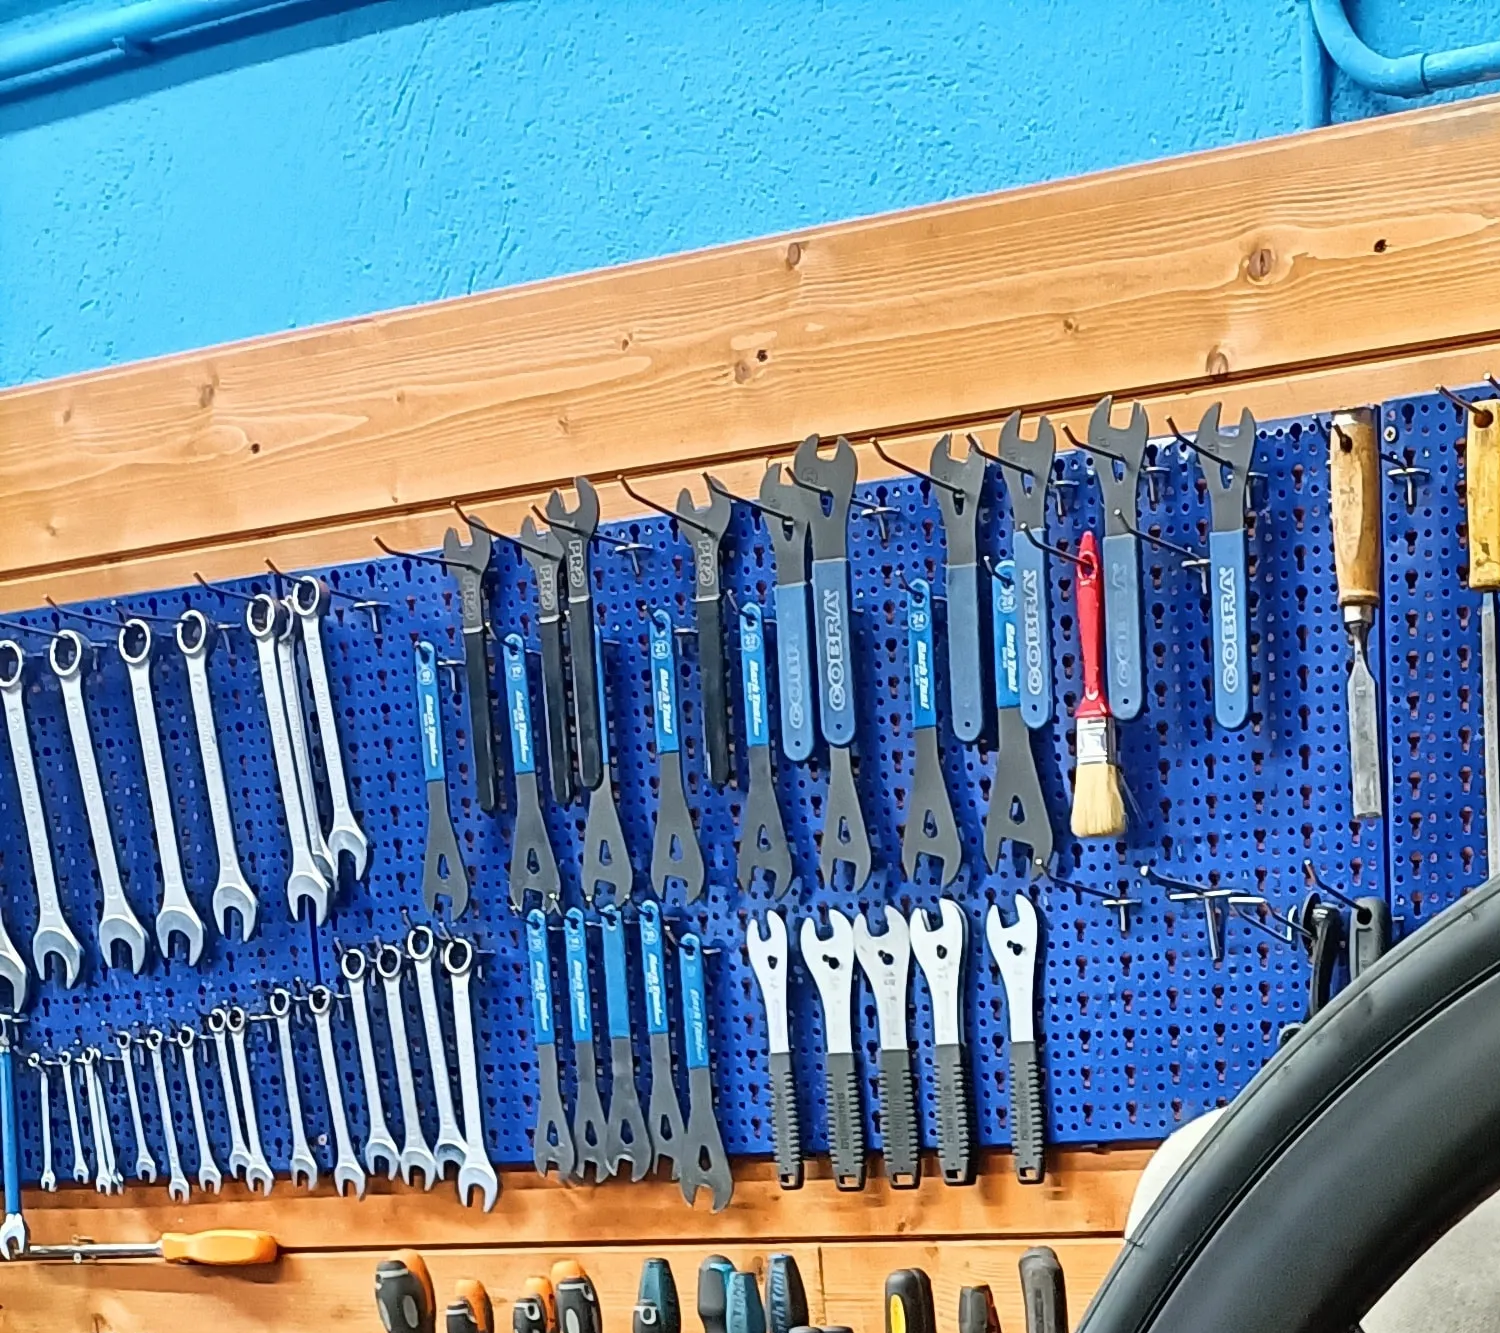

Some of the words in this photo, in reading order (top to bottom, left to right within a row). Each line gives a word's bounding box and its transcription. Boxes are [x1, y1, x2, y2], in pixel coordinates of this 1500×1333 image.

[823, 589, 847, 711] COBRA
[1022, 569, 1043, 696] COBRA
[1219, 567, 1240, 694] COBRA
